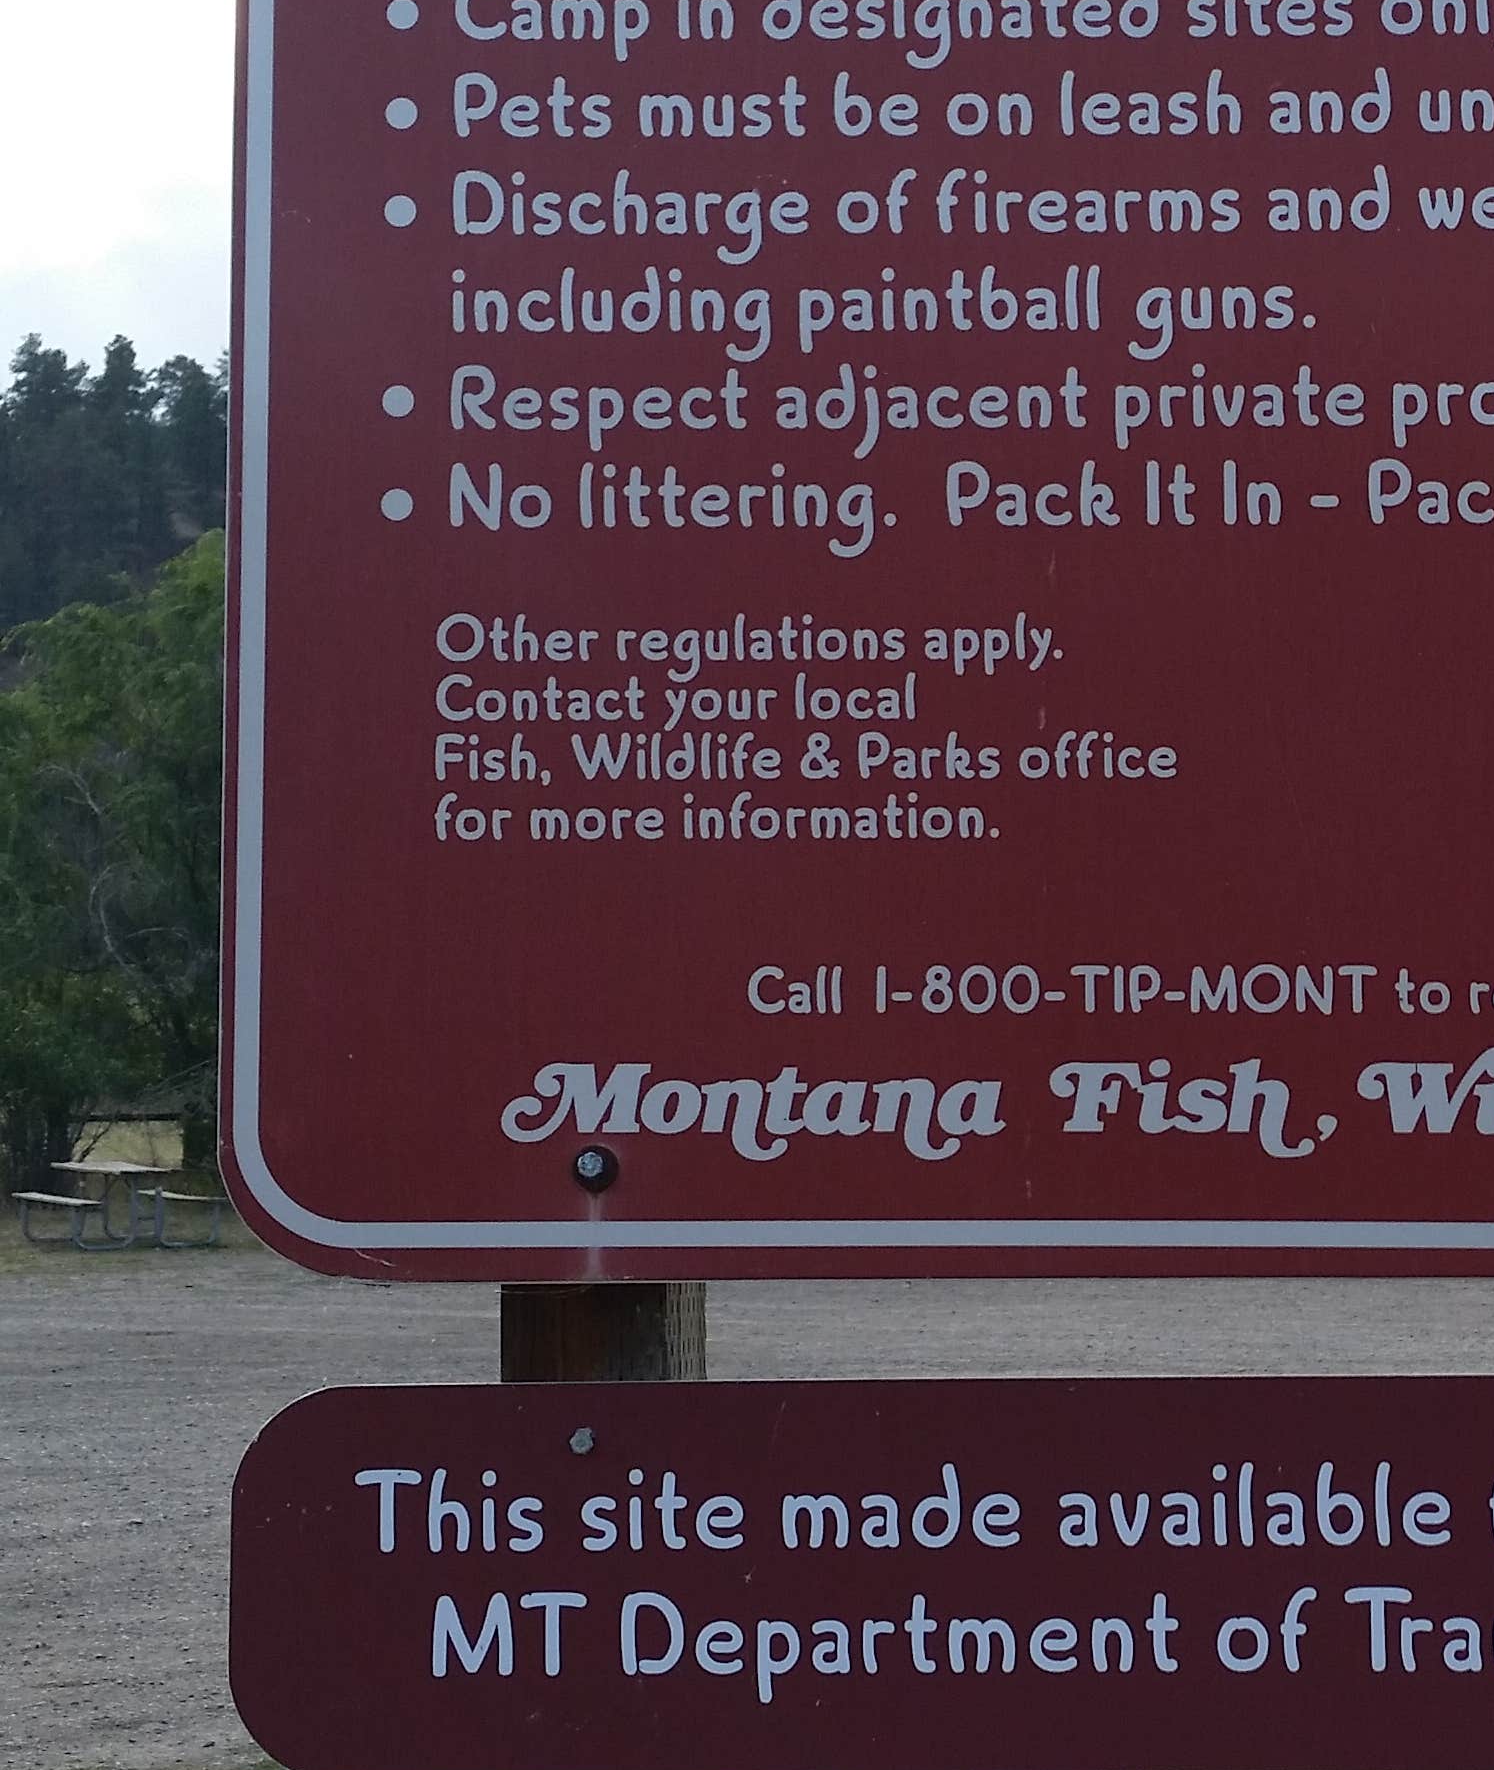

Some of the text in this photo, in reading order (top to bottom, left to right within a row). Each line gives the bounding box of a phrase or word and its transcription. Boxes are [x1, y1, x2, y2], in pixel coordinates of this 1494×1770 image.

[454, 73, 611, 137] Pets
[639, 76, 806, 137] must
[834, 72, 918, 136] be
[947, 93, 1032, 135] on
[1061, 69, 1241, 135] leash
[1270, 67, 1391, 133] and
[453, 170, 808, 264] Discharge
[837, 169, 917, 233] of
[936, 169, 1240, 233] firearms
[1269, 165, 1389, 231] and
[452, 265, 1315, 362] including paintball guns.
[451, 365, 747, 451] Respect
[776, 364, 1087, 459] adjacent
[1115, 364, 1364, 449] private
[450, 463, 551, 530] No
[580, 462, 896, 557] littering.
[947, 460, 1120, 526] Pack
[1147, 460, 1195, 525] It
[1224, 460, 1281, 525] In
[437, 612, 1063, 682] Other regulations apply.
[436, 672, 915, 731] Contact your local
[435, 731, 1176, 785] Fish, Wildlife & Parks office
[435, 792, 999, 840] for more information.
[748, 966, 841, 1013] Call
[1395, 969, 1450, 1013] to
[501, 1063, 1006, 1161] Montana
[1050, 1059, 1337, 1157] Fish,
[355, 1469, 543, 1552] This
[581, 1469, 743, 1551] site
[782, 1464, 1019, 1548] made
[1059, 1462, 1450, 1546] available
[433, 1592, 587, 1677] MT
[621, 1592, 1178, 1703] Department
[1217, 1587, 1316, 1672] of
